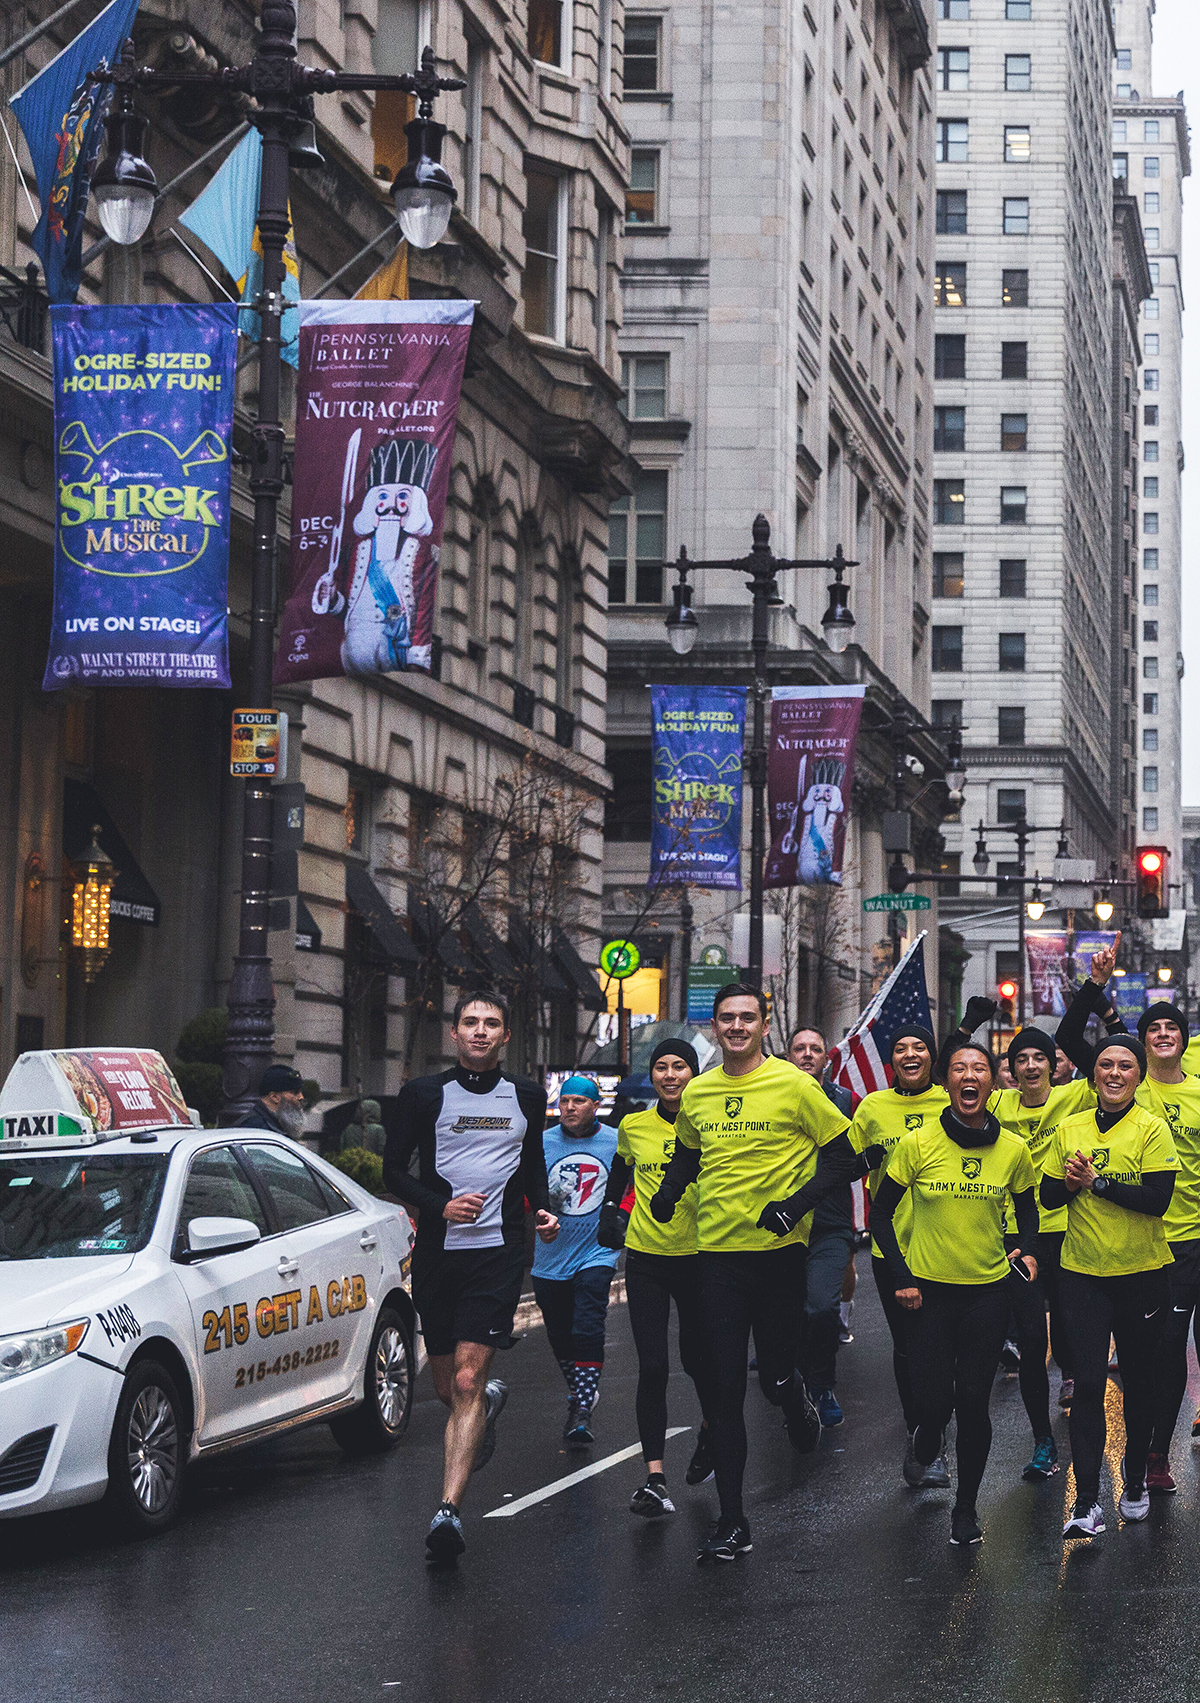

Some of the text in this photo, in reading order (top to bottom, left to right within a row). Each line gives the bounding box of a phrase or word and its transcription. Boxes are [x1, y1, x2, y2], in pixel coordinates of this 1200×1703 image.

[320, 333, 451, 346] PENNSYLVANIA
[317, 349, 392, 362] BALLET
[74, 353, 211, 371] OGRE-SIZED
[63, 373, 222, 393] HOLIDAY FUN!
[332, 381, 363, 389] GEORGE
[300, 515, 333, 532] DEC
[66, 617, 100, 633] LIVE
[104, 617, 134, 631] ON
[81, 653, 217, 669] WALNUT STREET THEATRE
[287, 653, 309, 663] Cigna
[101, 669, 125, 678] AND
[128, 669, 173, 678] WALNUT
[176, 670, 218, 679] STREETS
[239, 714, 272, 724] TOUR
[662, 711, 734, 721] OGRE-SIZED
[781, 711, 822, 719] BALLET
[656, 722, 740, 733] HOLIDAY FUN!
[235, 763, 275, 773] STOP 19
[776, 802, 795, 811] DEC
[680, 852, 697, 860] ON
[865, 900, 915, 911] WALNUT
[115, 1070, 150, 1089] FLAVOR
[117, 1090, 156, 1110] WELCOME
[6, 1115, 54, 1137] TAXI
[457, 1116, 512, 1126] WEST POINT
[700, 1121, 771, 1133] ARMY WEST POINT
[1115, 1171, 1141, 1182] POINT
[928, 1182, 956, 1192] ARMY
[959, 1183, 985, 1193] WEST
[203, 1274, 368, 1354] 215 GET A CAB
[96, 1303, 142, 1347] P-0408
[234, 1339, 340, 1389] 215-438-2222
